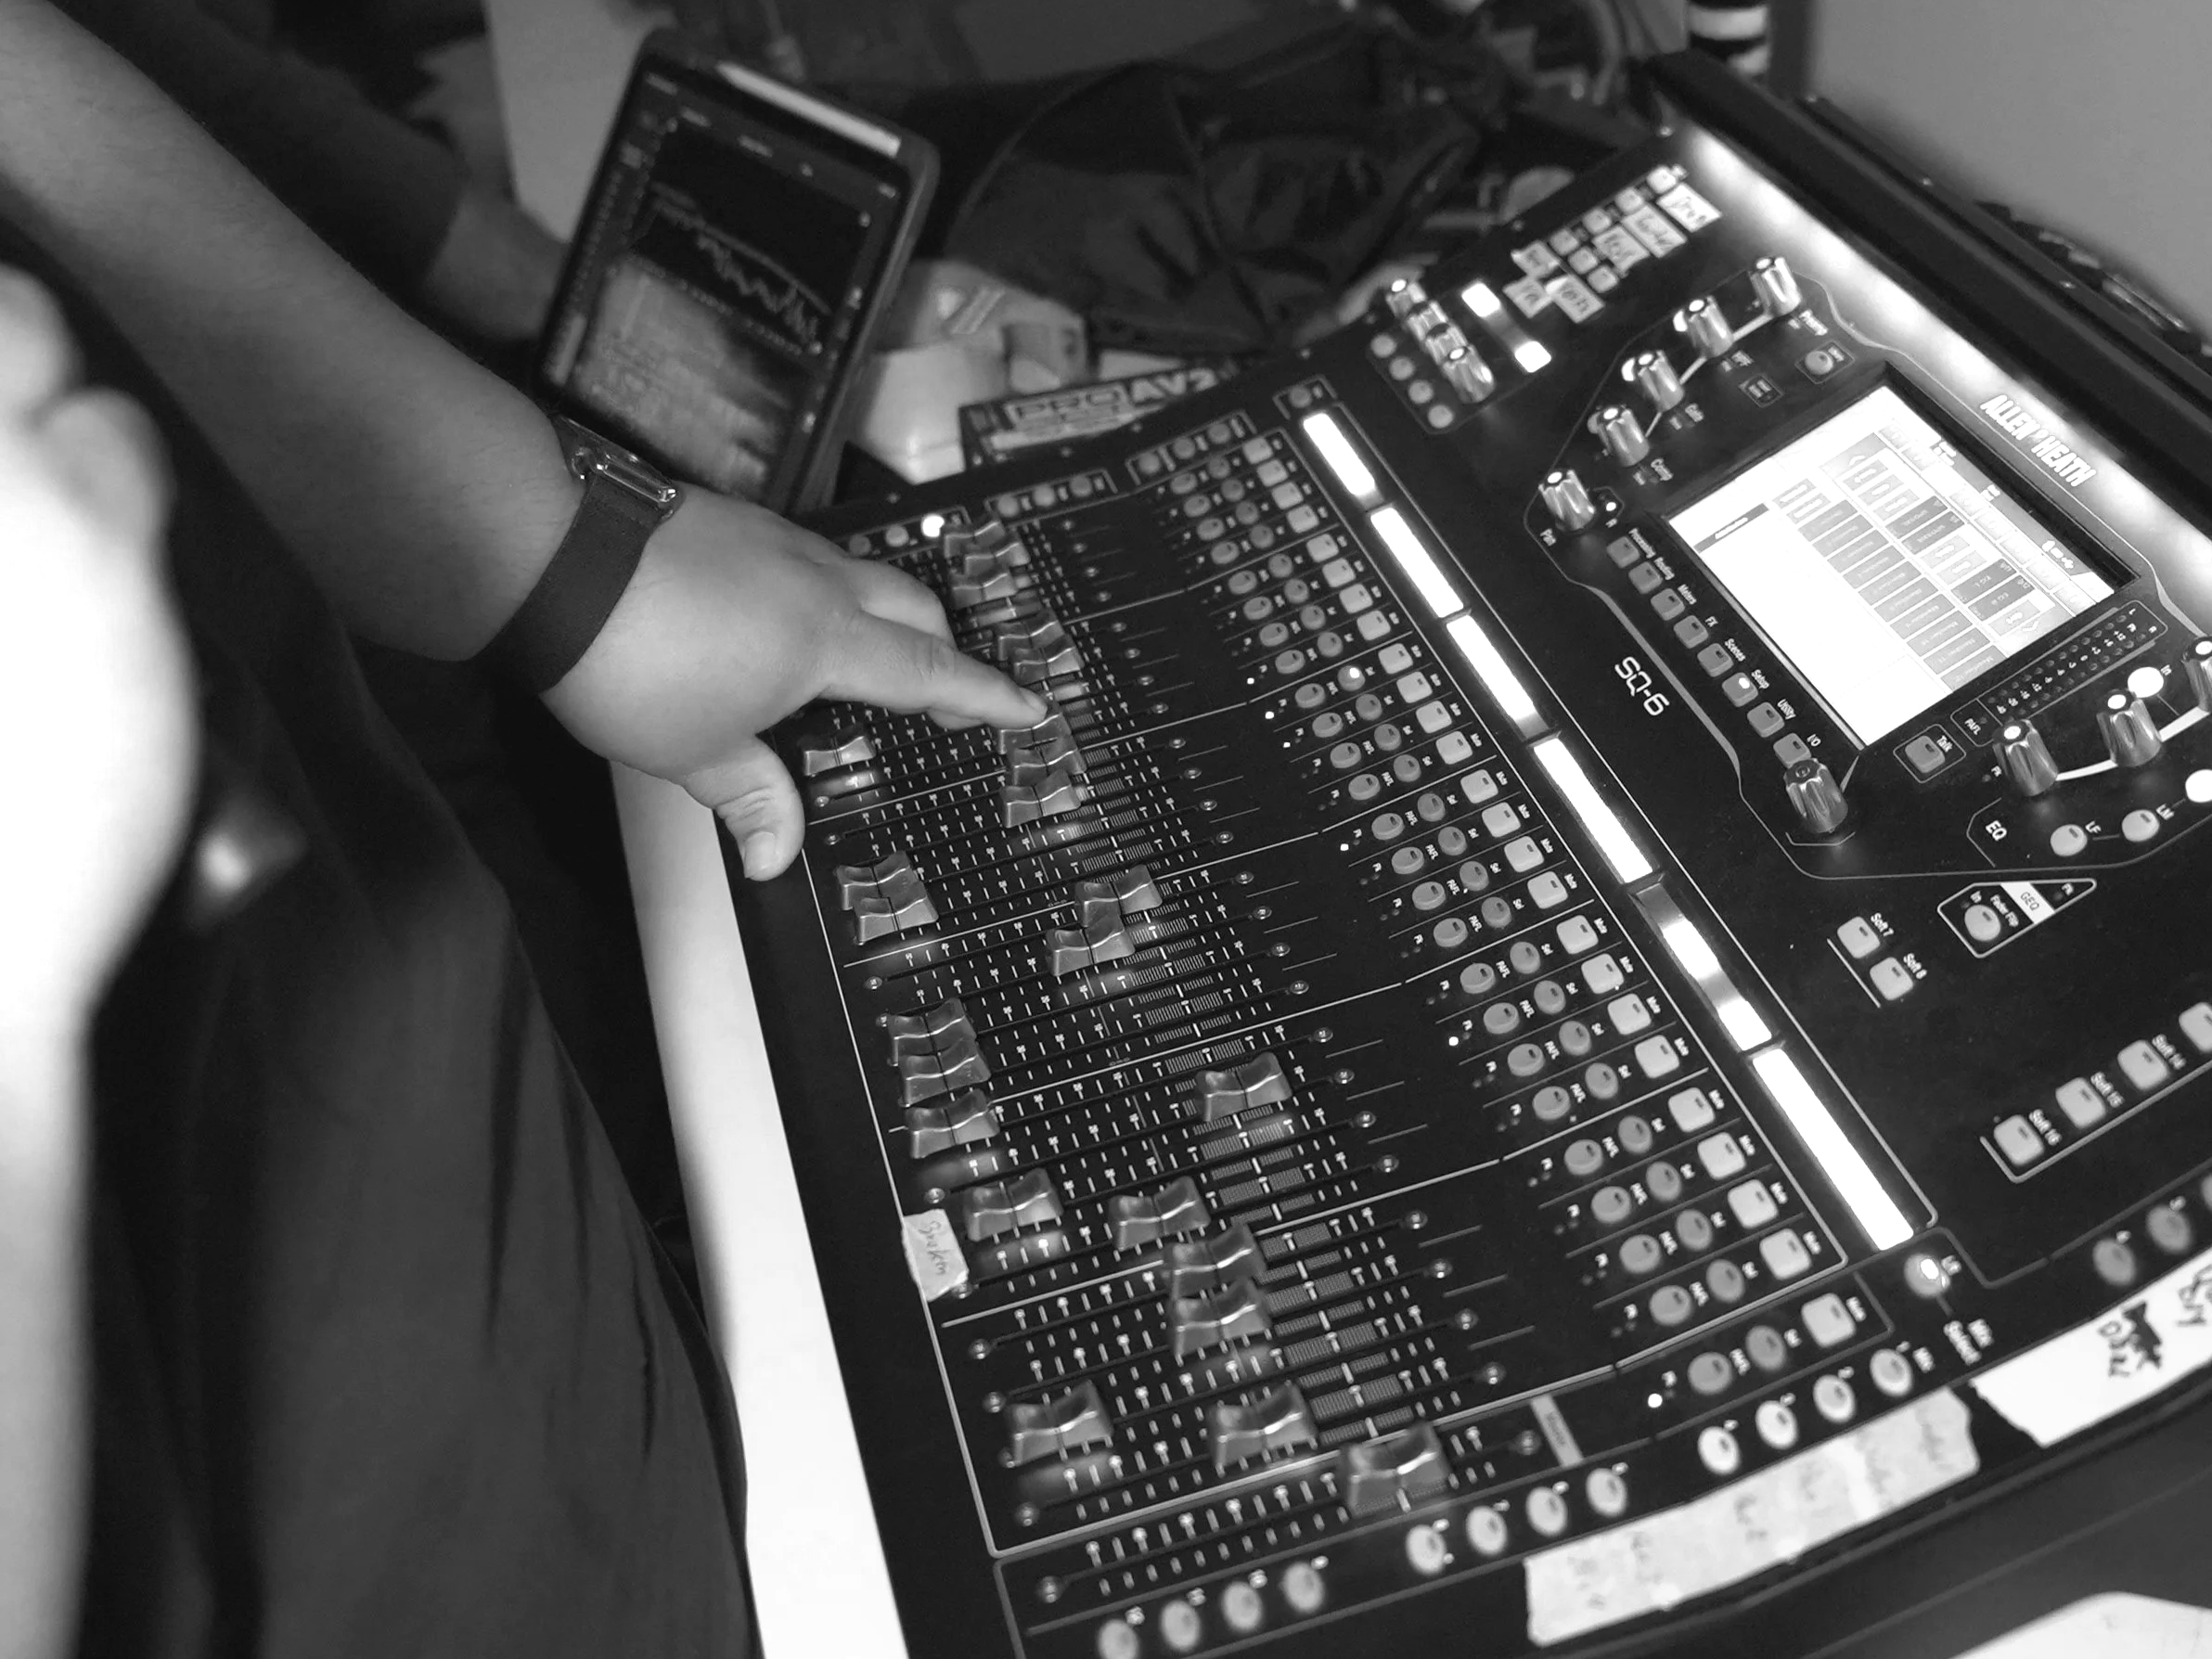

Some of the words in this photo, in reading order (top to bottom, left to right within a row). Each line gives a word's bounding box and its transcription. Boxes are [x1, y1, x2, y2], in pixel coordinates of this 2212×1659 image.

[1979, 393, 2038, 441] ALLEN
[2030, 435, 2098, 488] HEATH
[1651, 458, 1673, 481] Comp
[1540, 529, 1556, 546] Pan
[1628, 528, 1656, 559] Processing
[1653, 557, 1675, 580] Routing
[1678, 584, 1697, 605] Meters
[1705, 616, 1718, 627] FX
[1725, 638, 1745, 662] Scenes
[1751, 669, 1769, 688] Setup
[2160, 664, 2172, 675] In
[1614, 657, 1669, 715] SQ-6
[1777, 699, 1796, 719] Utility
[1964, 718, 1981, 735] PAFL
[1936, 735, 1952, 752] Talk
[1991, 765, 2001, 777] Pk
[2155, 804, 2174, 819] LM
[1986, 820, 2007, 841] EQ
[2085, 821, 2101, 833] LF
[1971, 891, 1982, 903] In
[2062, 882, 2074, 895] Pk
[1990, 894, 2009, 915] Fader
[2005, 911, 2019, 927] Flip
[2020, 892, 2039, 911] GEQ
[1869, 911, 1885, 932] Soft
[1903, 953, 1922, 973] Soft
[2152, 1034, 2172, 1058] Soft
[2090, 1073, 2113, 1095] Soft
[2029, 1110, 2051, 1133] Soft
[1944, 1321, 1980, 1363] Select
